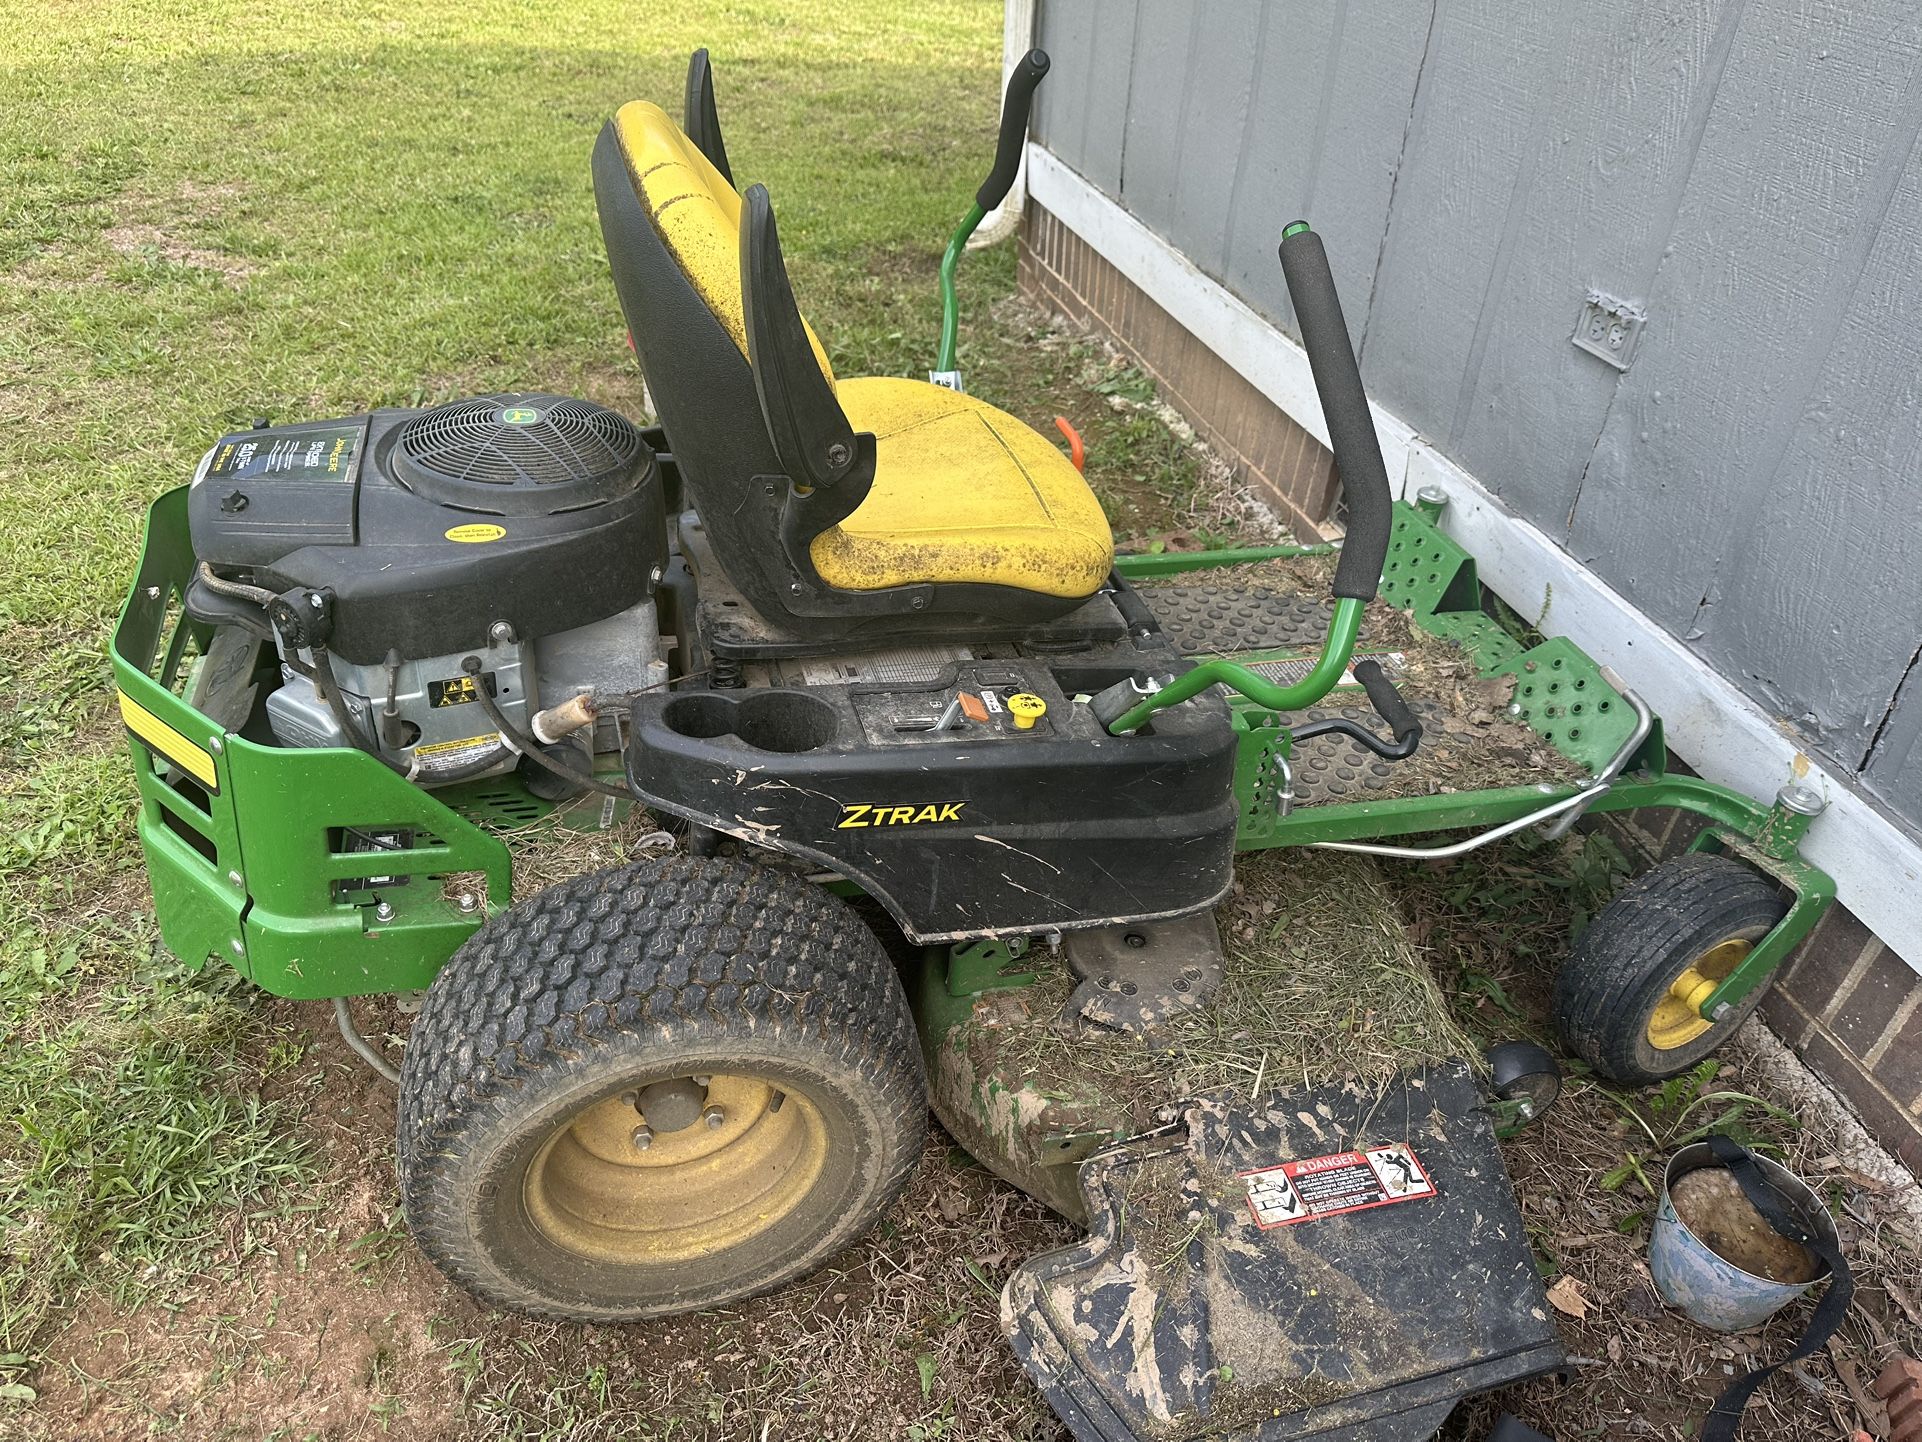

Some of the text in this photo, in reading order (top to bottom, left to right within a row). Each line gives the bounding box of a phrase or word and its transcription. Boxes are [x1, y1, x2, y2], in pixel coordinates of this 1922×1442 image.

[838, 802, 966, 828] ZTRAK
[1307, 1153, 1358, 1171] DANGER
[1304, 1165, 1357, 1180] ROTATING BLADE
[1309, 1178, 1365, 1192] THROWN OBJECTS
